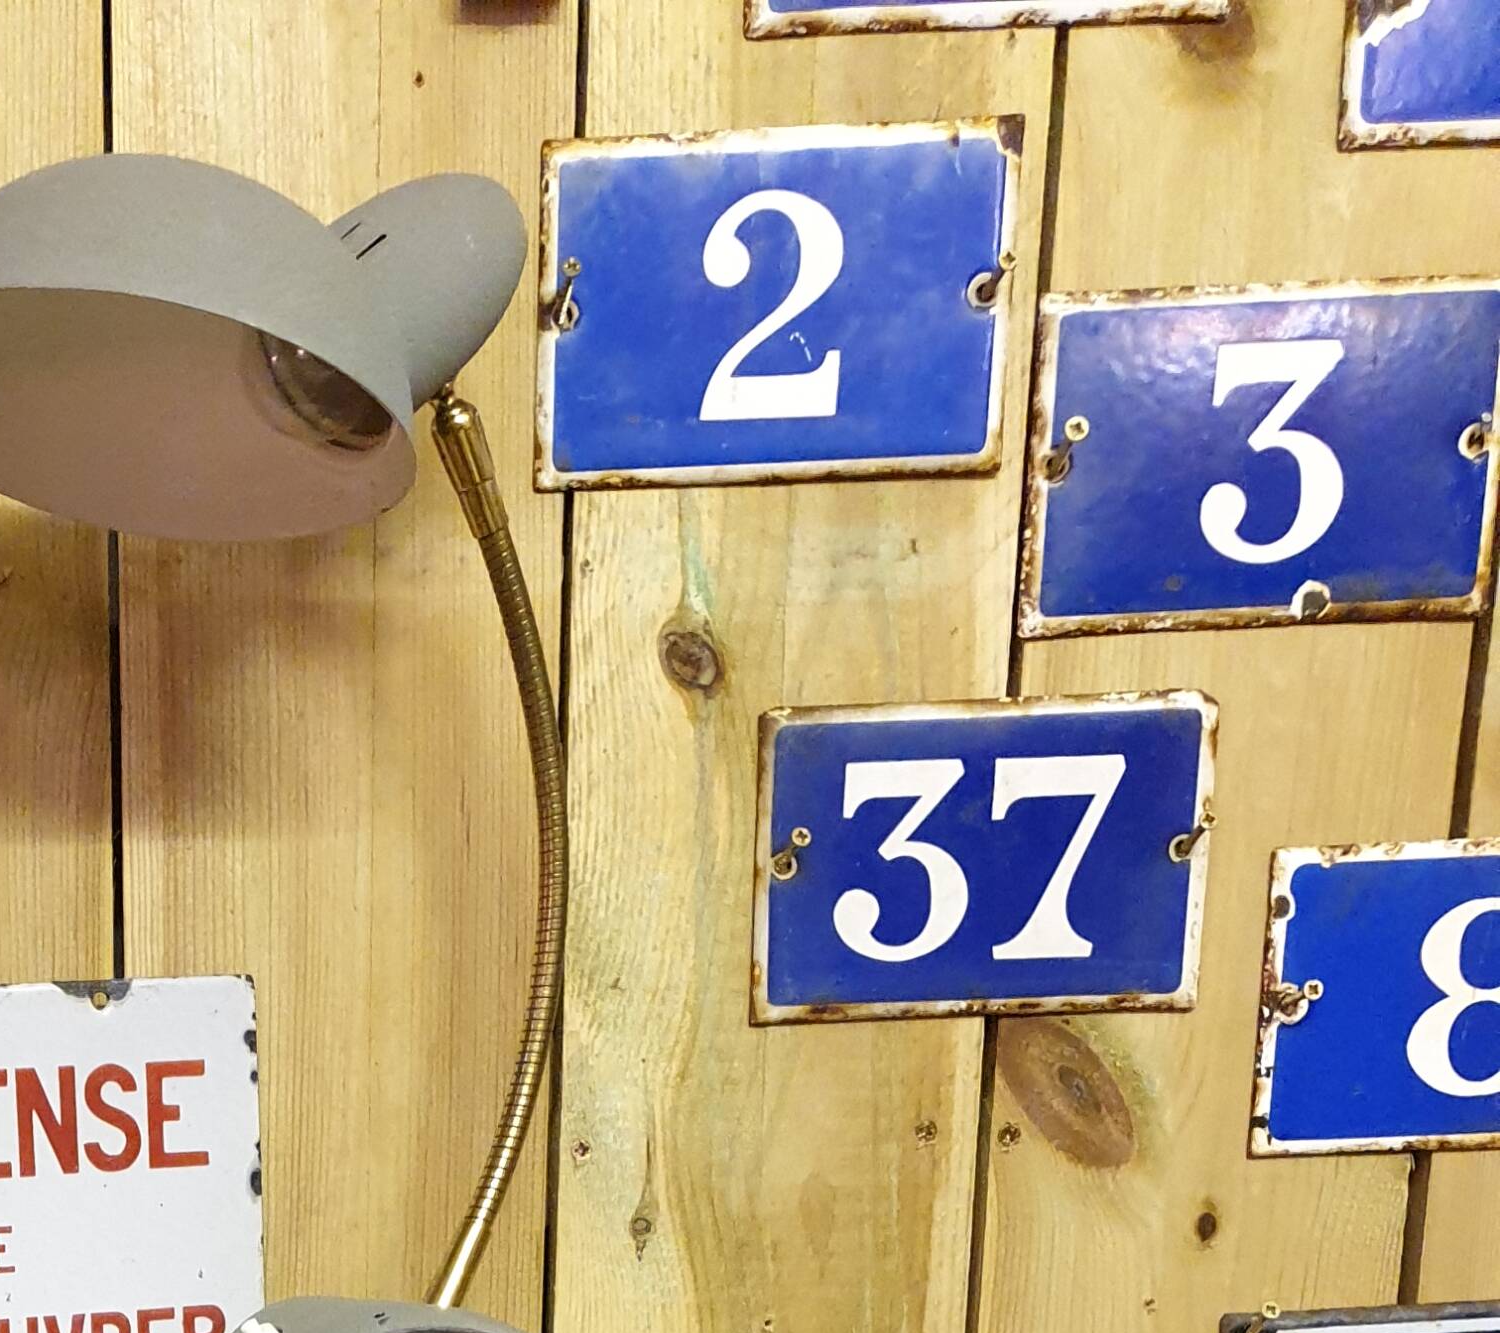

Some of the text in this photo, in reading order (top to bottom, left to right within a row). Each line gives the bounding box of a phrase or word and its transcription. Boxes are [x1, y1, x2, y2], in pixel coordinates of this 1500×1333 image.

[699, 188, 844, 422] 2
[1198, 338, 1346, 565] 3
[832, 753, 1127, 963] 37
[1405, 896, 1500, 1098] 8
